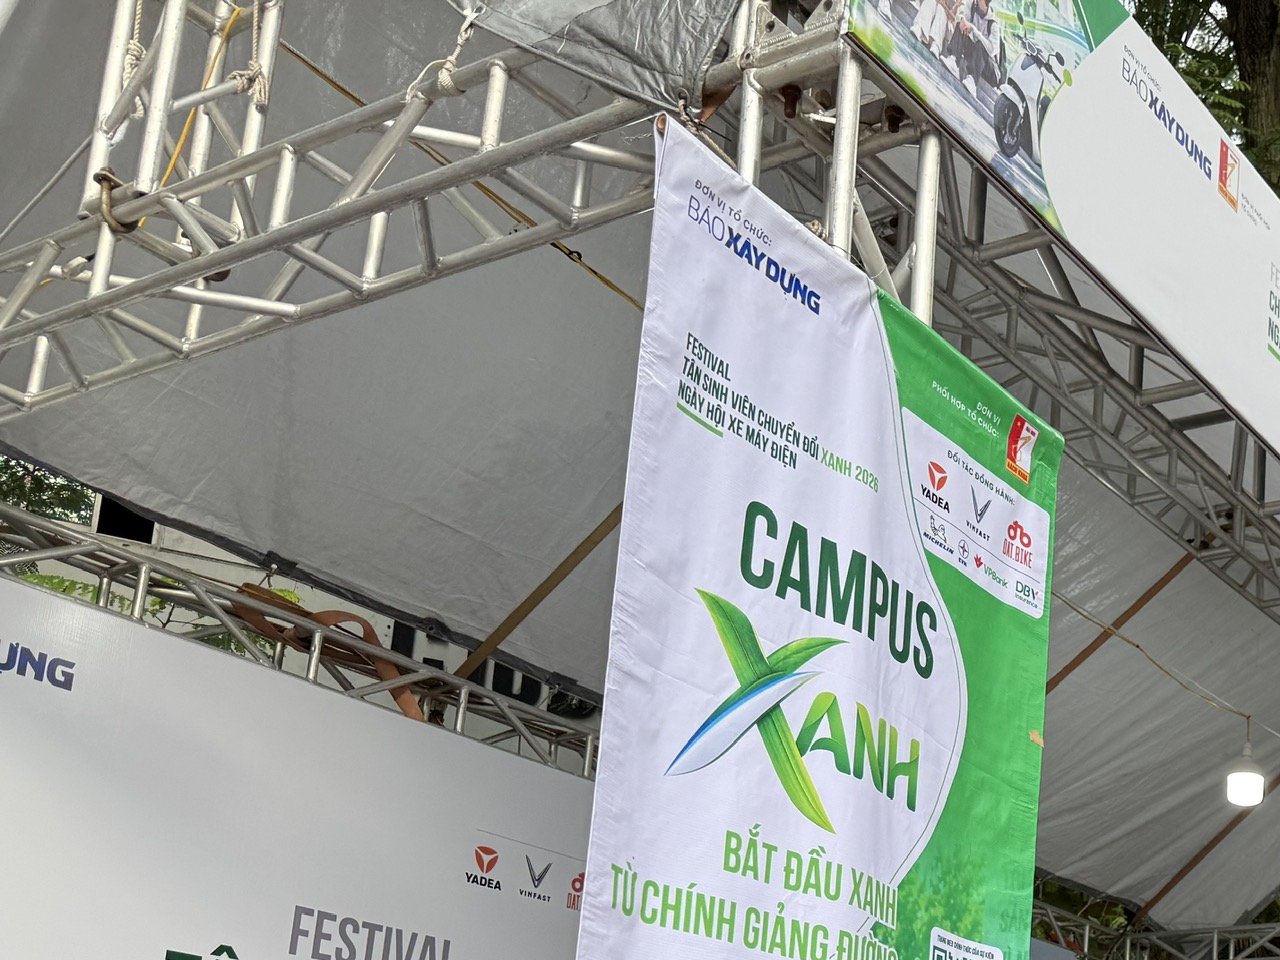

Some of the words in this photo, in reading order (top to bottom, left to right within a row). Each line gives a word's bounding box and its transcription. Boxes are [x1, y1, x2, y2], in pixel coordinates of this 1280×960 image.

[687, 194, 725, 242] BÁO
[694, 179, 716, 202] ĐƠN
[717, 197, 727, 214] VỊ
[728, 206, 743, 222] TỔ
[743, 218, 773, 247] CHỨC:
[686, 331, 731, 382] FESTIVAL
[932, 380, 950, 401] PHỐI
[677, 379, 705, 414] NGÀY
[706, 401, 726, 429] HỘI
[728, 414, 744, 438] XE
[745, 425, 769, 453] MÁY
[771, 441, 798, 470] ĐIỆN
[681, 355, 702, 386] TÂN
[702, 373, 729, 404] SINH
[731, 390, 756, 422] VIÊN
[757, 409, 801, 449] CHUYỂN
[802, 435, 819, 461] ĐỔI
[821, 447, 852, 477] XANH
[855, 465, 879, 494] 2026
[976, 402, 992, 417] ĐƠN
[993, 413, 1001, 427] VỊ
[947, 449, 961, 466] ĐỐI
[962, 459, 974, 476] TÁC
[920, 483, 951, 514] YADEA
[922, 532, 954, 555] MICHELIN
[966, 520, 991, 542] VINFAST
[739, 500, 938, 680] CAMPUS
[983, 564, 1008, 588] VPBank
[1015, 581, 1039, 600] DBV
[465, 872, 502, 891] YADEA
[722, 823, 778, 885] BẮT
[783, 845, 843, 902] ĐẦU
[848, 867, 897, 930] XANH
[519, 888, 551, 903] VINFAST
[610, 861, 638, 917] TỪ
[640, 882, 737, 944] CHÍNH
